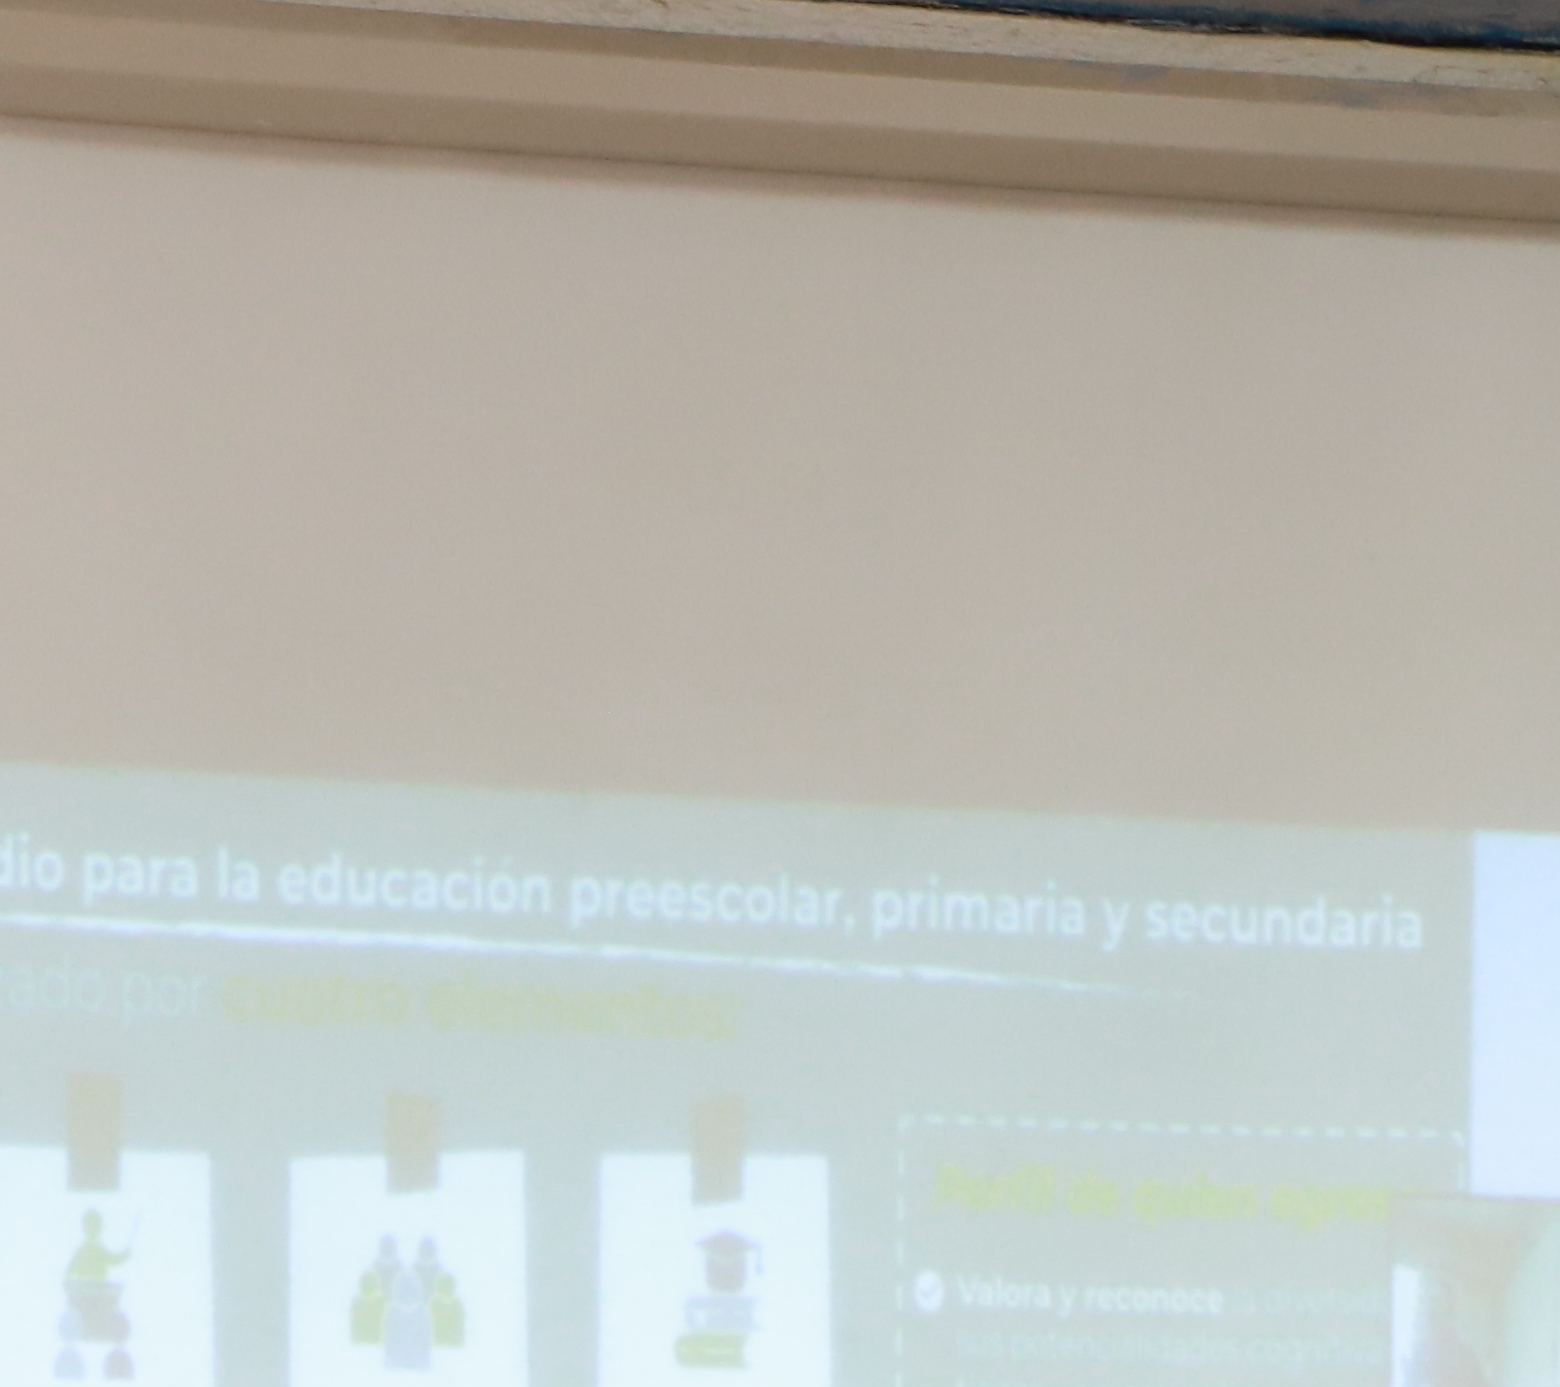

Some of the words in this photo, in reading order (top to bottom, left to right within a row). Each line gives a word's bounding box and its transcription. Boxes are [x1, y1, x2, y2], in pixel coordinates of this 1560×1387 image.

[82, 846, 199, 905] para
[216, 844, 262, 902] la
[278, 850, 552, 919] educación
[570, 872, 857, 936] preescolar,
[872, 880, 1088, 941] primaria
[1099, 894, 1131, 952] y
[1144, 892, 1425, 951] secundaria
[122, 966, 208, 1032] por
[954, 1273, 1052, 1312] Valora
[1058, 1283, 1078, 1320] y
[1082, 1286, 1226, 1317] reconoce
